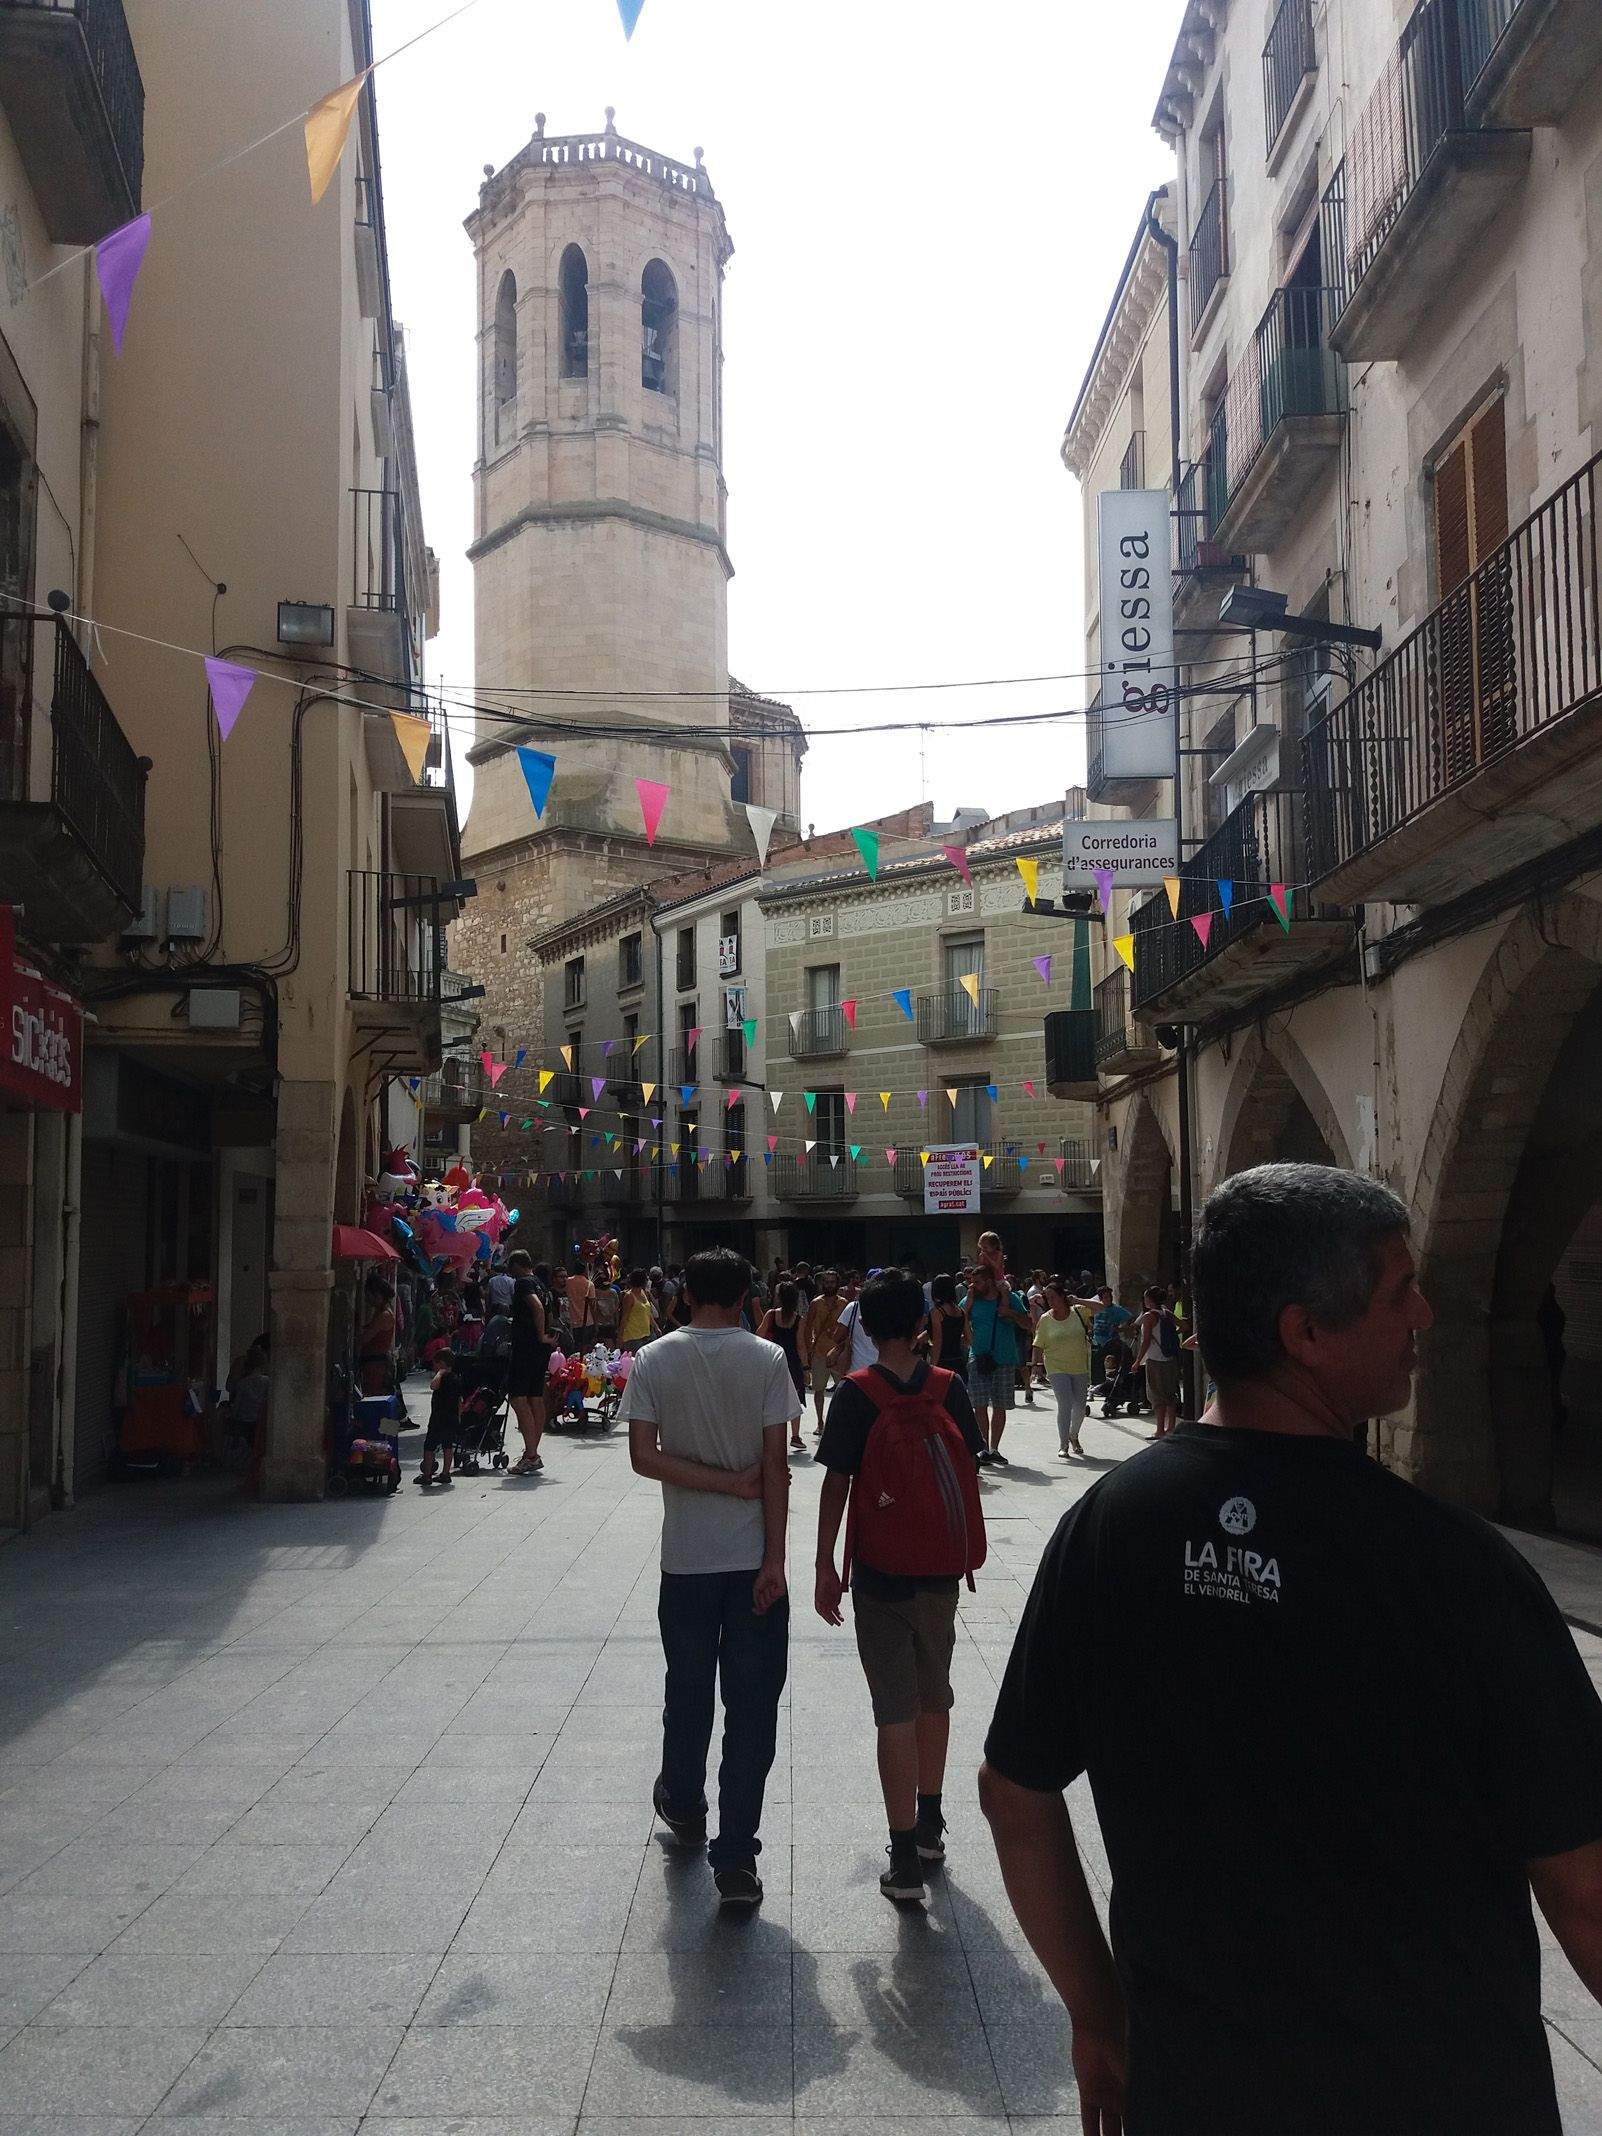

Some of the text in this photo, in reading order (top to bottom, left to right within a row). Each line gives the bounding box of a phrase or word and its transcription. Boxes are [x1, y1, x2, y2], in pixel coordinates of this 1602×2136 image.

[1108, 531, 1169, 714] giessa
[1081, 834, 1157, 850] Corredoria
[1184, 1540, 1281, 1588] LA FIRA
[1184, 1569, 1200, 1581] DE
[1203, 1570, 1241, 1588] SANTA
[1184, 1584, 1251, 1604] EL VENDRELL
